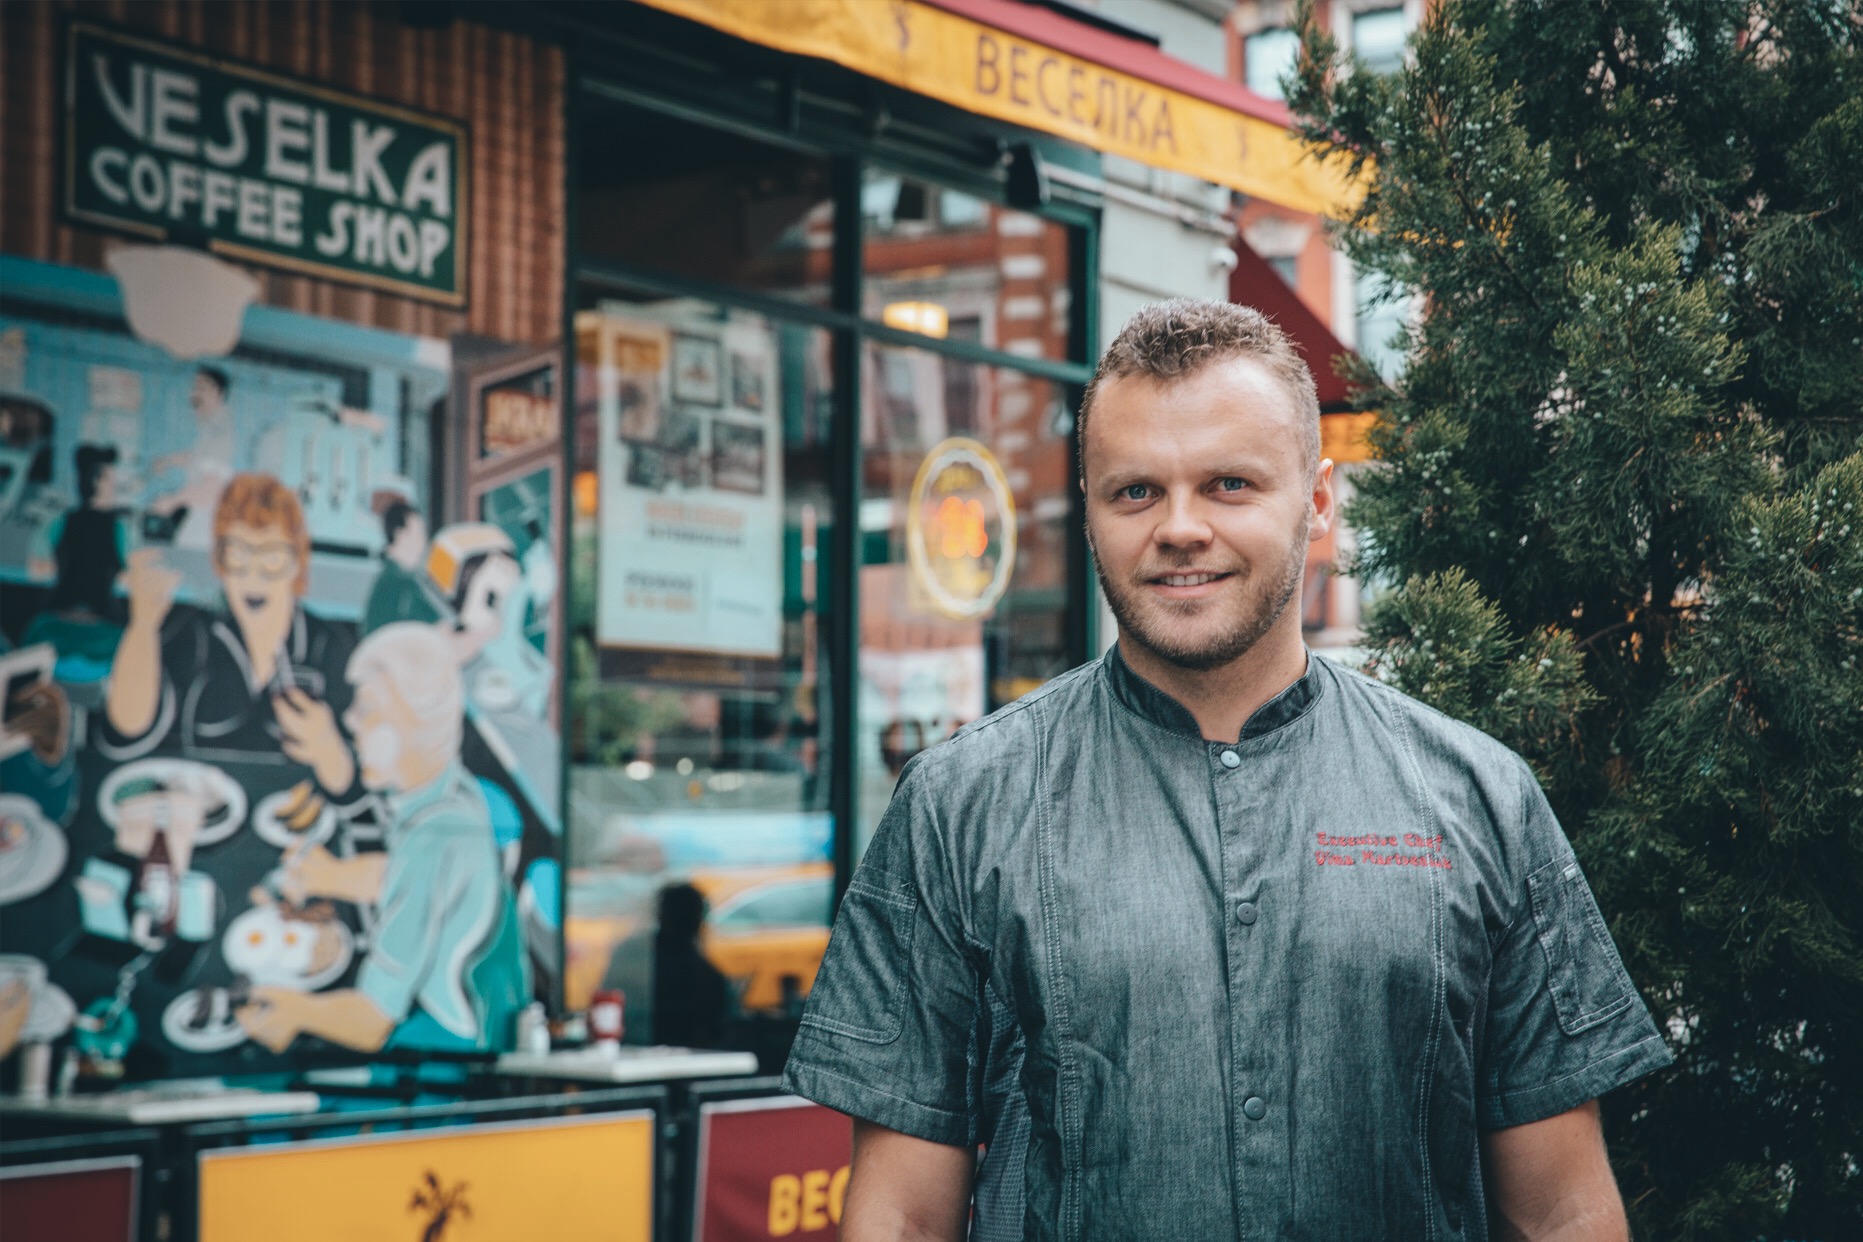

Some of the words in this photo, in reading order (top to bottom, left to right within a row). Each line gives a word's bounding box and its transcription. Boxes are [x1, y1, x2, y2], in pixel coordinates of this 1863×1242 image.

[92, 53, 452, 217] VESELKA
[974, 33, 1179, 155] ВЕСЕЛКА
[90, 147, 303, 248] COFFEE
[315, 201, 450, 278] SHOP
[1316, 831, 1399, 847] Executive
[1403, 832, 1443, 853] Chef
